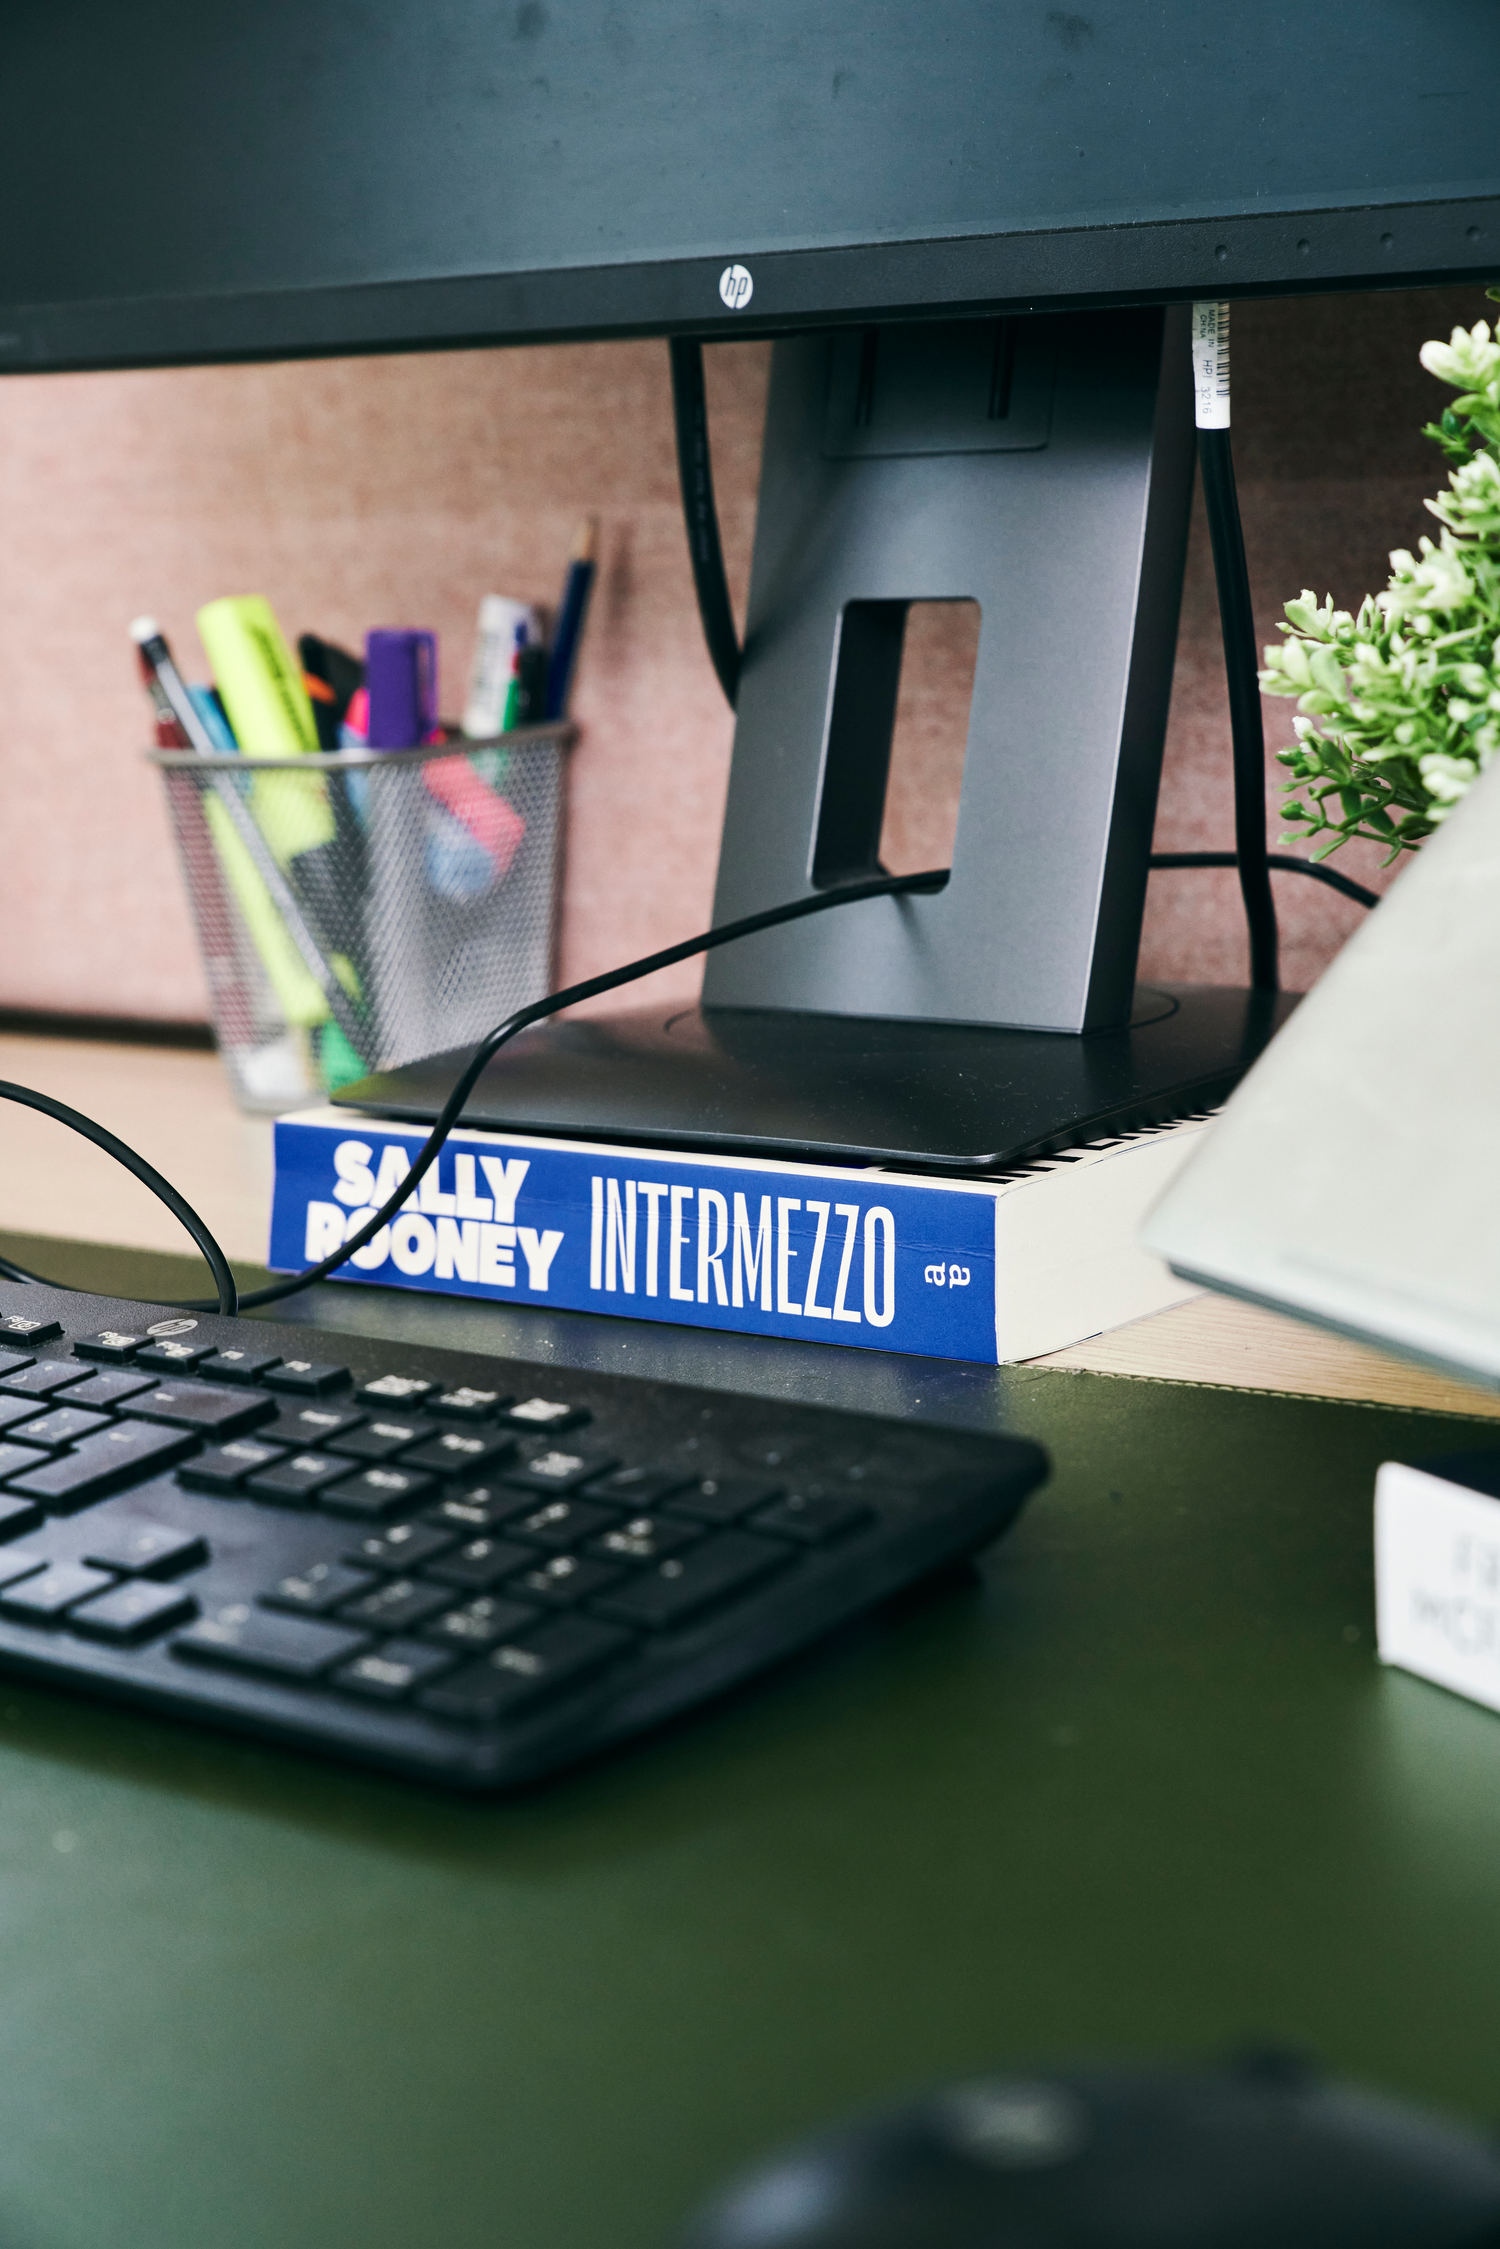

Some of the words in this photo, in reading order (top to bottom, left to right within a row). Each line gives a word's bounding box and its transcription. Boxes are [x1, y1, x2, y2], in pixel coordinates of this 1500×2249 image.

[720, 264, 752, 310] hp
[1207, 309, 1216, 335] MADE
[1208, 338, 1215, 348] IN
[1201, 386, 1212, 414] 3216
[332, 1139, 531, 1224] SALLY
[304, 1200, 565, 1292] ROONEY
[589, 1176, 896, 1328] INTERMEZZO
